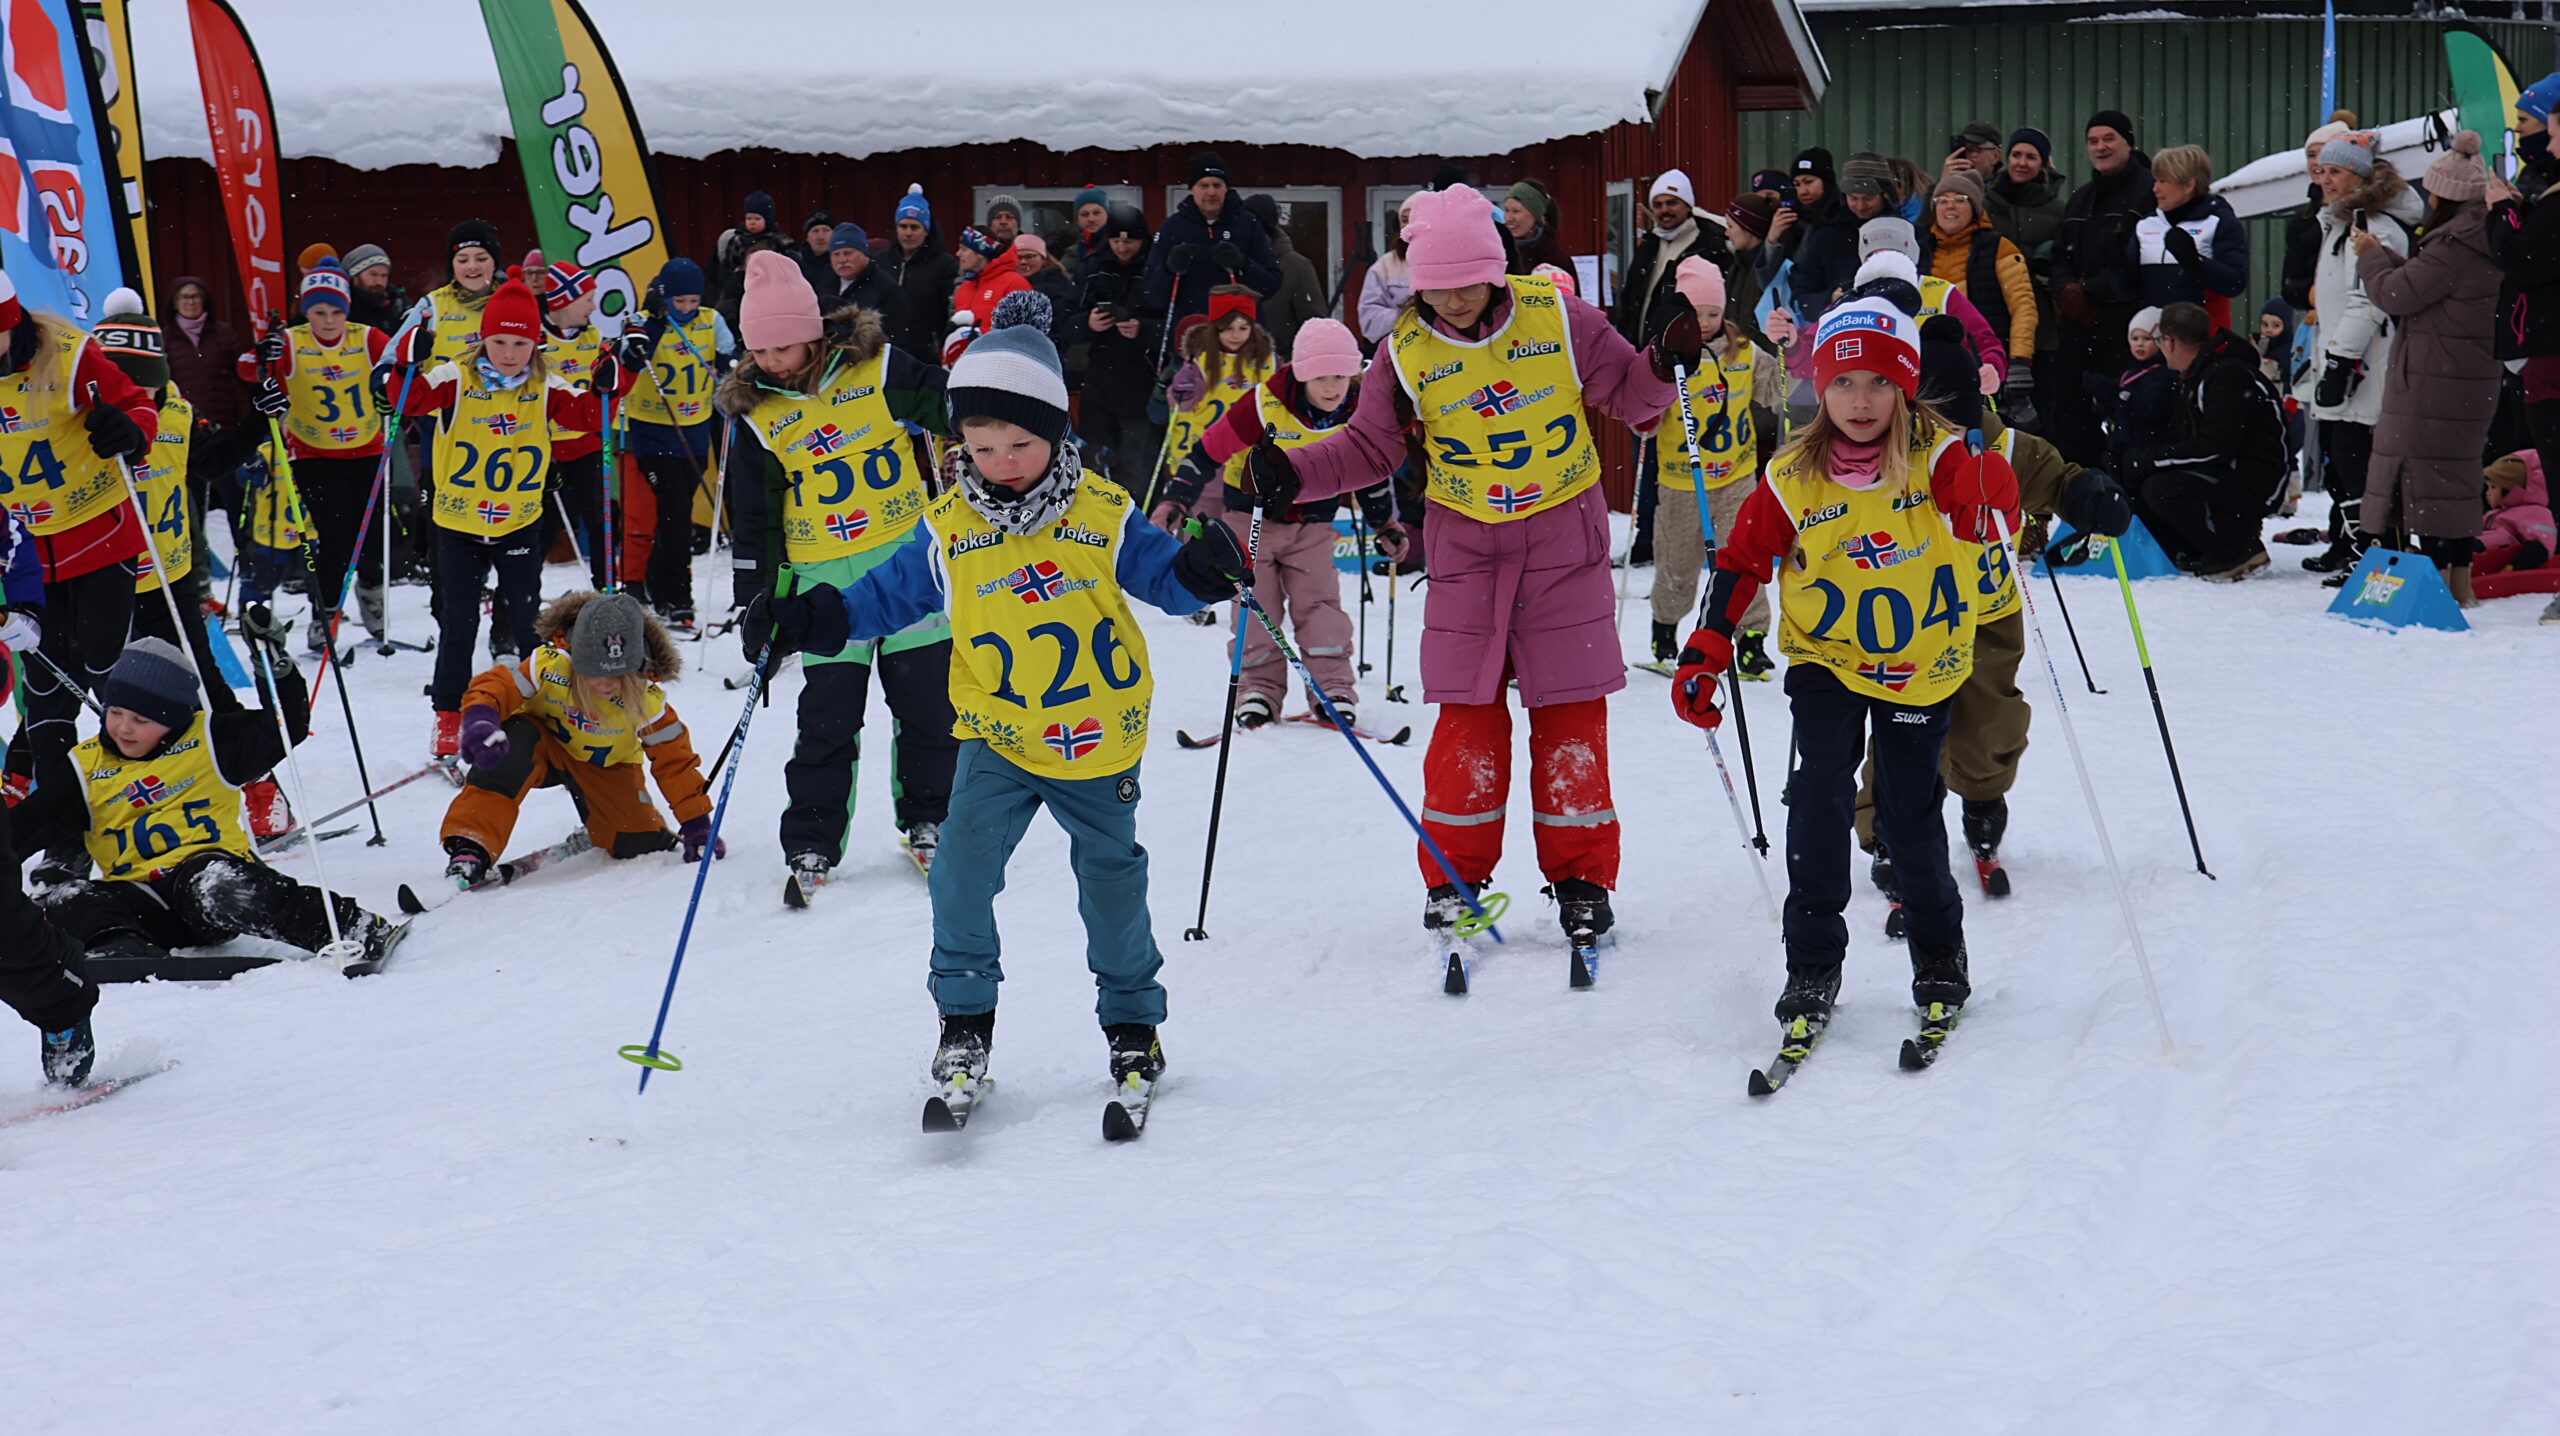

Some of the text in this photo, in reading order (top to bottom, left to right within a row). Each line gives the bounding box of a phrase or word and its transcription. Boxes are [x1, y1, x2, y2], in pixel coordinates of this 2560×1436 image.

[540, 62, 654, 342] oker
[1509, 338, 1560, 362] joker
[1418, 360, 1462, 388] joker
[312, 383, 366, 423] 31
[834, 385, 874, 407] joker
[770, 410, 802, 439] joker
[449, 440, 544, 493] 262
[1055, 518, 1108, 548] joker
[1799, 502, 1846, 533] joker
[949, 528, 1001, 561] joker
[976, 569, 1025, 599] Barnas
[1800, 563, 1969, 655] 204
[969, 615, 1142, 710] 226
